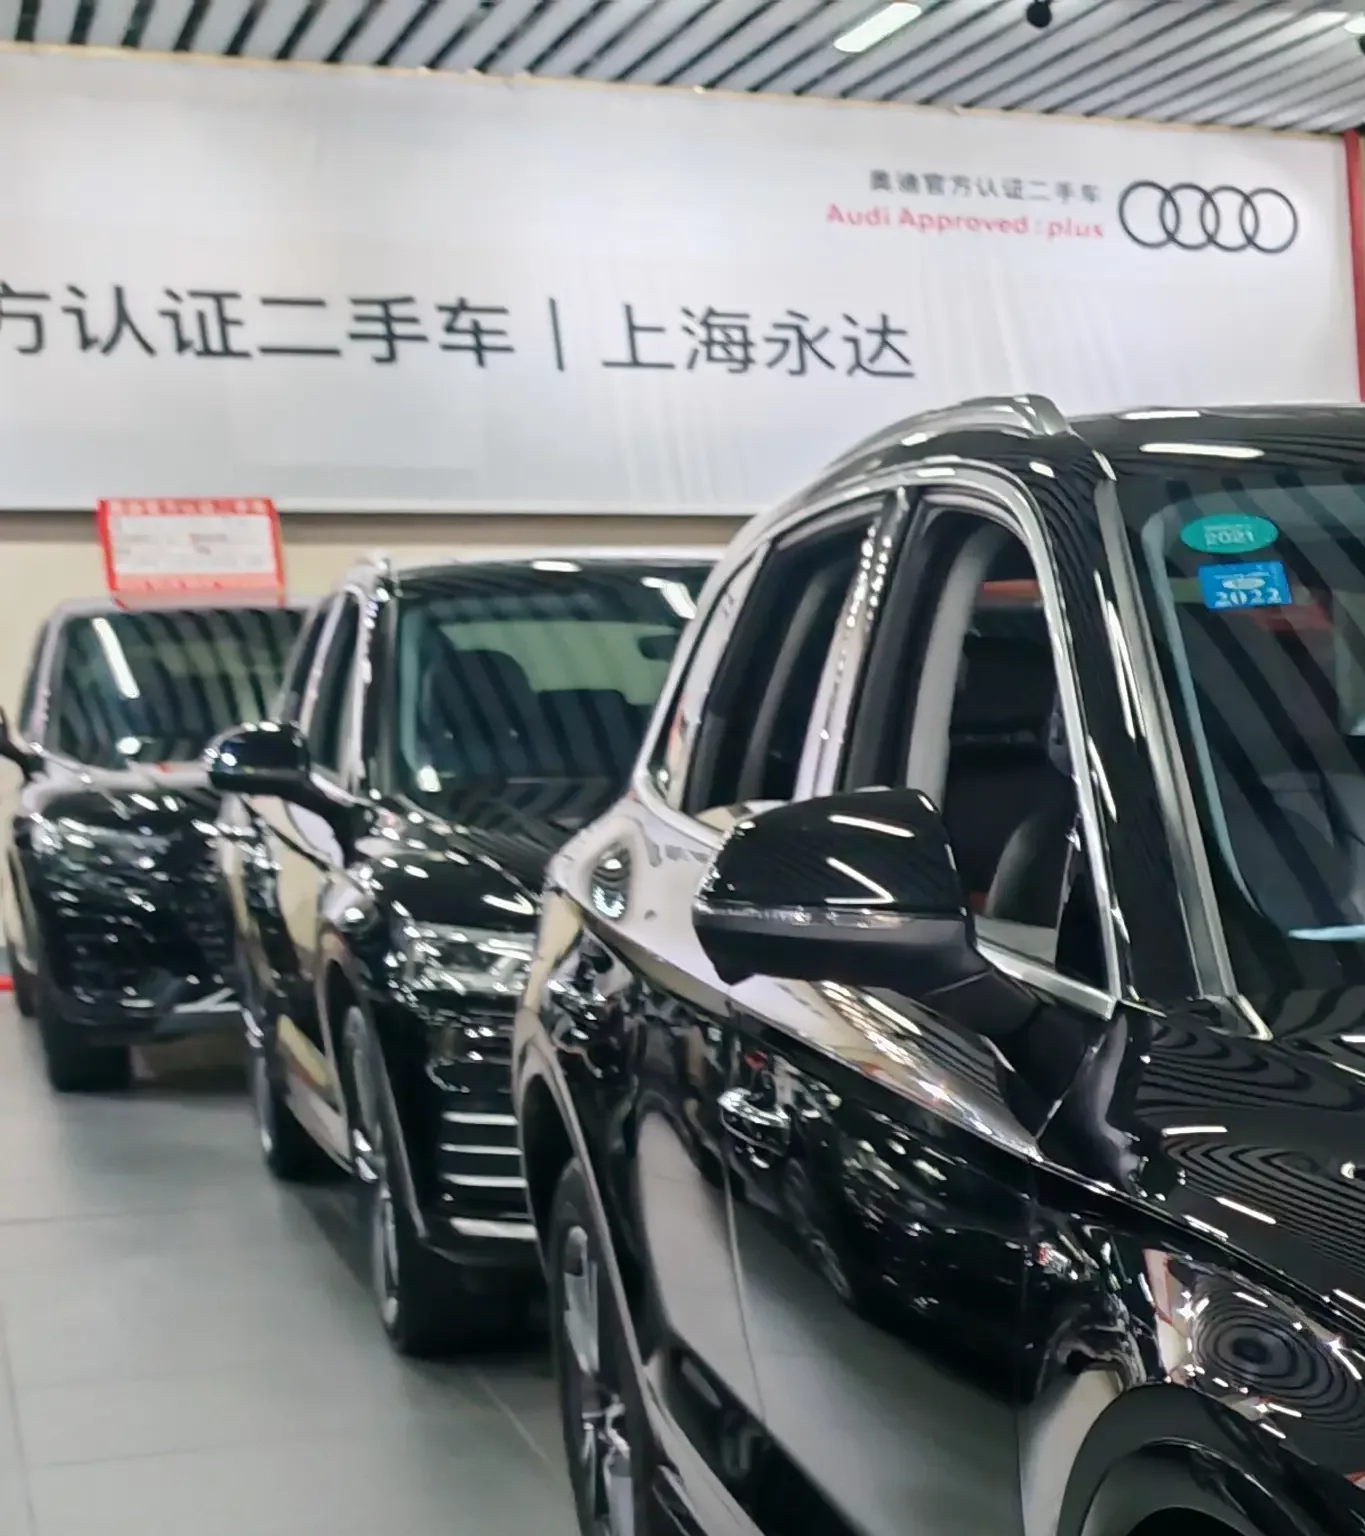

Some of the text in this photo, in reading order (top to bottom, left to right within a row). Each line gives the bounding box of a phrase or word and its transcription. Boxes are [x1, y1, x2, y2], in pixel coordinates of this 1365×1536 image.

[869, 168, 1103, 205] 奥迪官方认证二手车
[826, 203, 892, 227] Audi
[899, 208, 1030, 237] Approved
[601, 303, 916, 377] 上海永达
[1204, 529, 1255, 547] 2021
[1214, 587, 1282, 609] 2022
